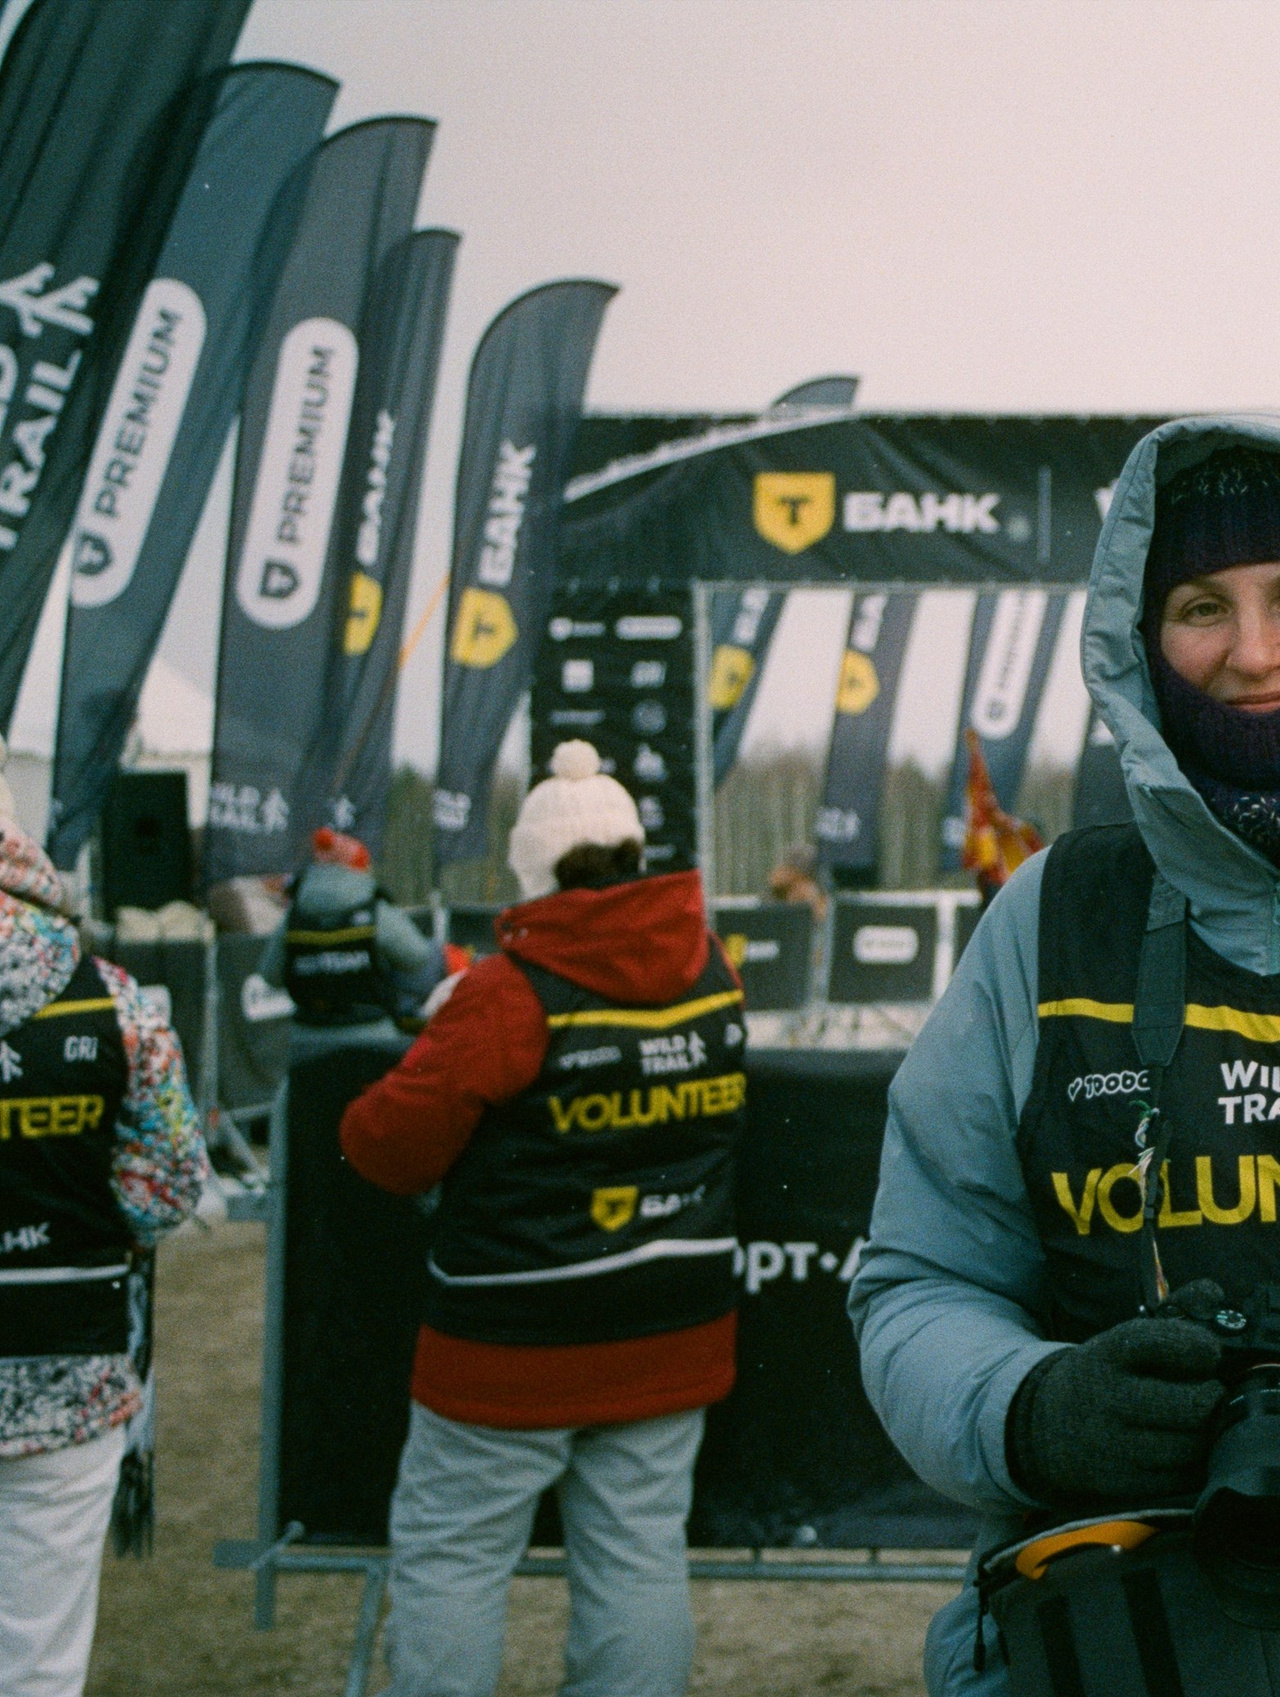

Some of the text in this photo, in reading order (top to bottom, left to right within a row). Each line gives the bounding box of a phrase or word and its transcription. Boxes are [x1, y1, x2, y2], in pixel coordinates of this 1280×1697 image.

[93, 306, 182, 518] PREMIUM
[276, 345, 335, 546] PREMIUM
[480, 439, 537, 586] БАНК
[843, 491, 1001, 533] БАНК
